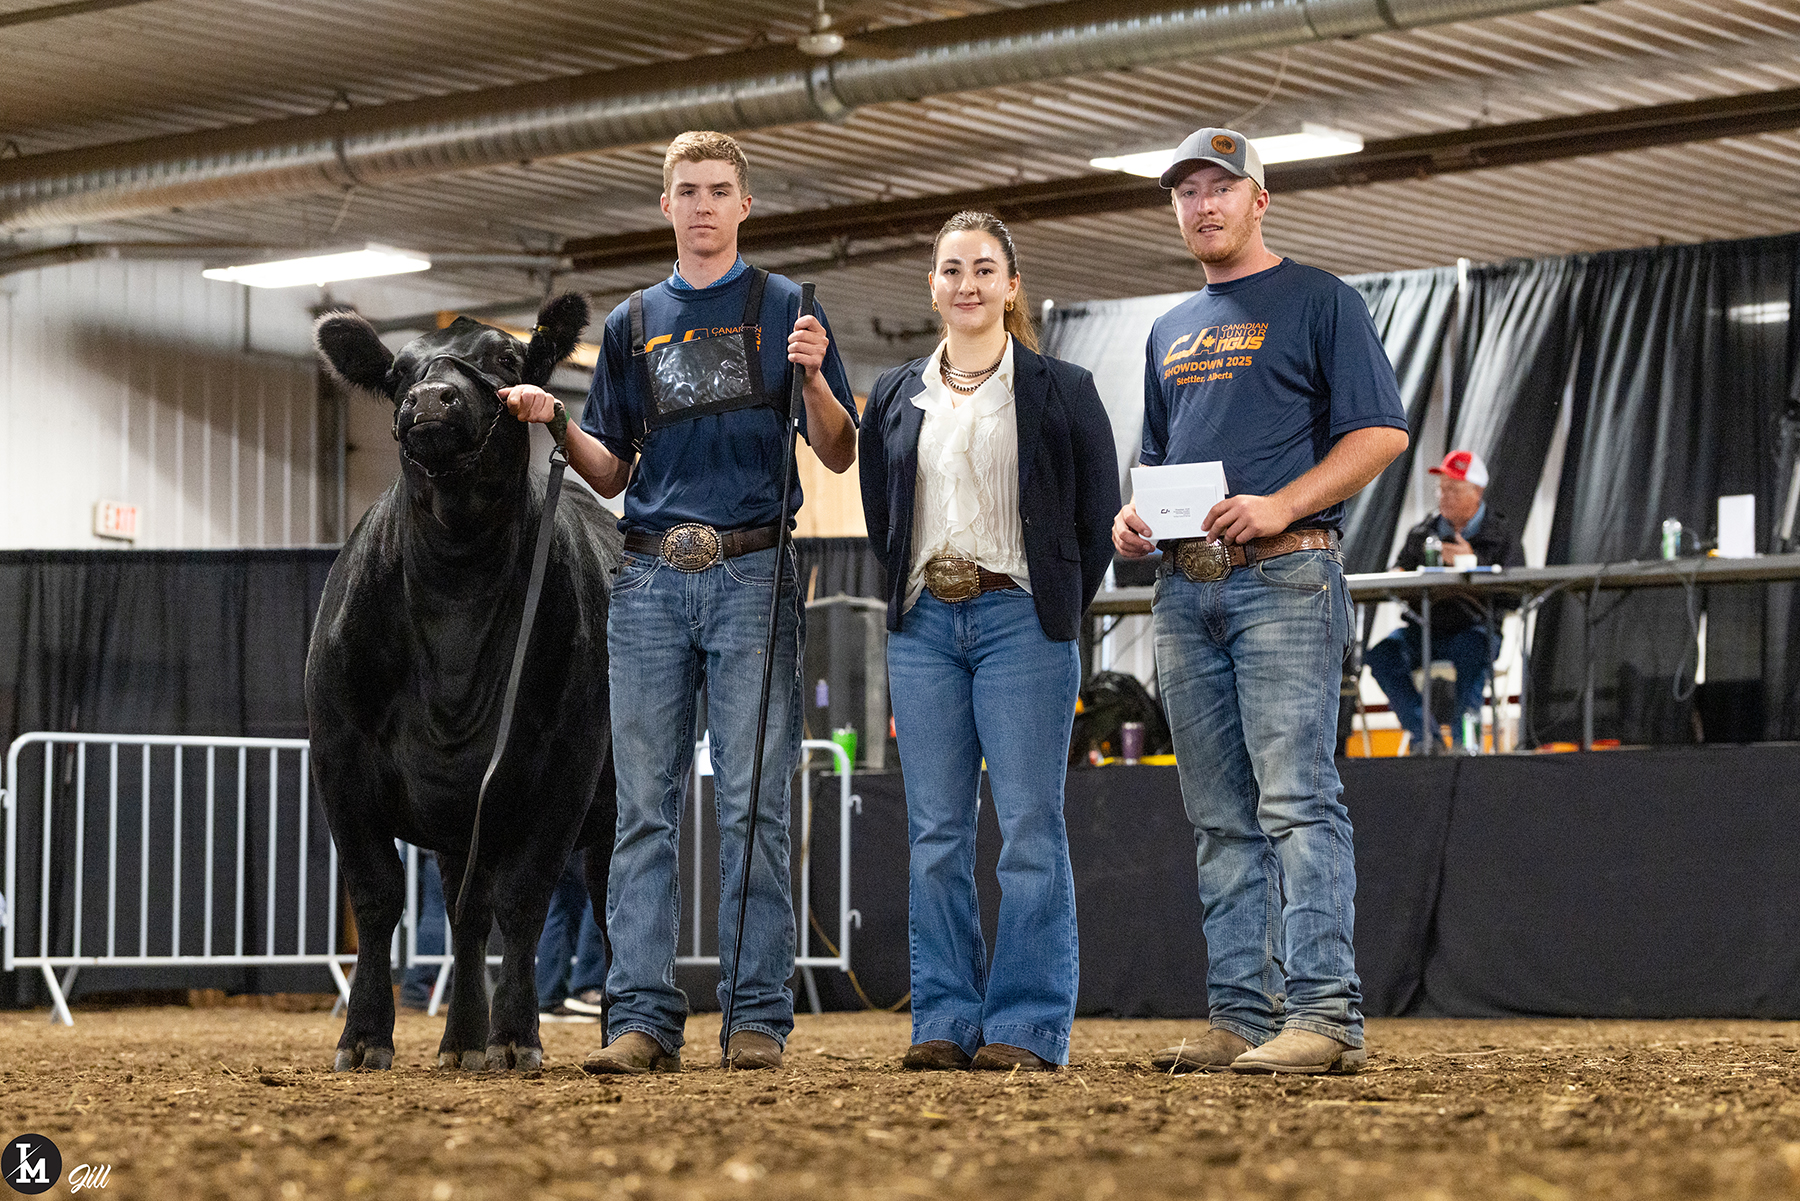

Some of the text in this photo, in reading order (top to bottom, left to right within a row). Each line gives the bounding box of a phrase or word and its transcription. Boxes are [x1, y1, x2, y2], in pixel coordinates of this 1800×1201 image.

[711, 326, 762, 335] CANAN
[1221, 323, 1268, 332] CANADIAN
[1220, 328, 1266, 339] JUNIOR
[1164, 356, 1253, 380] SHOWDOWN 2025
[1176, 371, 1233, 386] Stettler, Alberta
